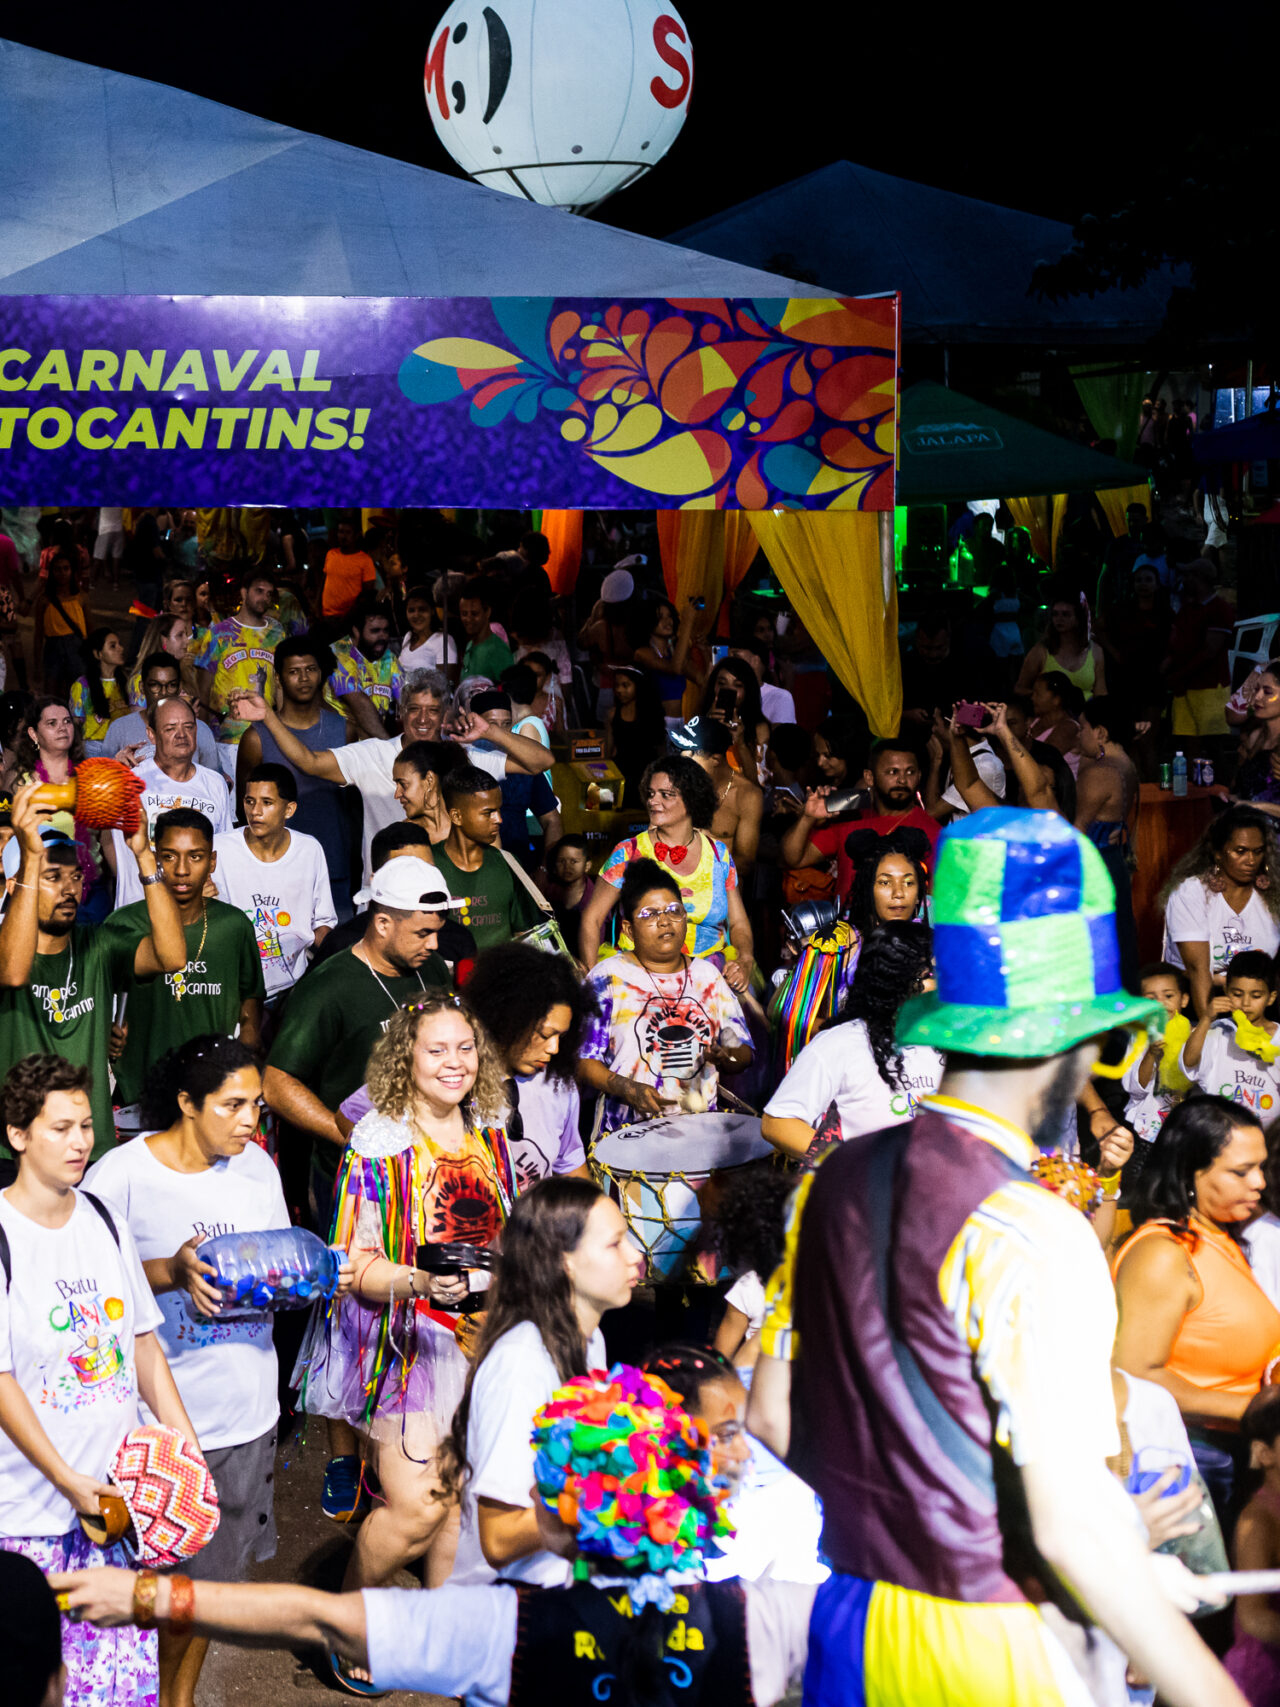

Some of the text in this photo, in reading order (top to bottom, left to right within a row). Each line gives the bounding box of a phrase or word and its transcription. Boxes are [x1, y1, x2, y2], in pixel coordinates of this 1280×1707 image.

[252, 893, 280, 907] Batu
[900, 1074, 934, 1090] Batu
[1235, 1070, 1266, 1088] Batu
[55, 1279, 98, 1300] Batu
[48, 1293, 125, 1333] CANTO
